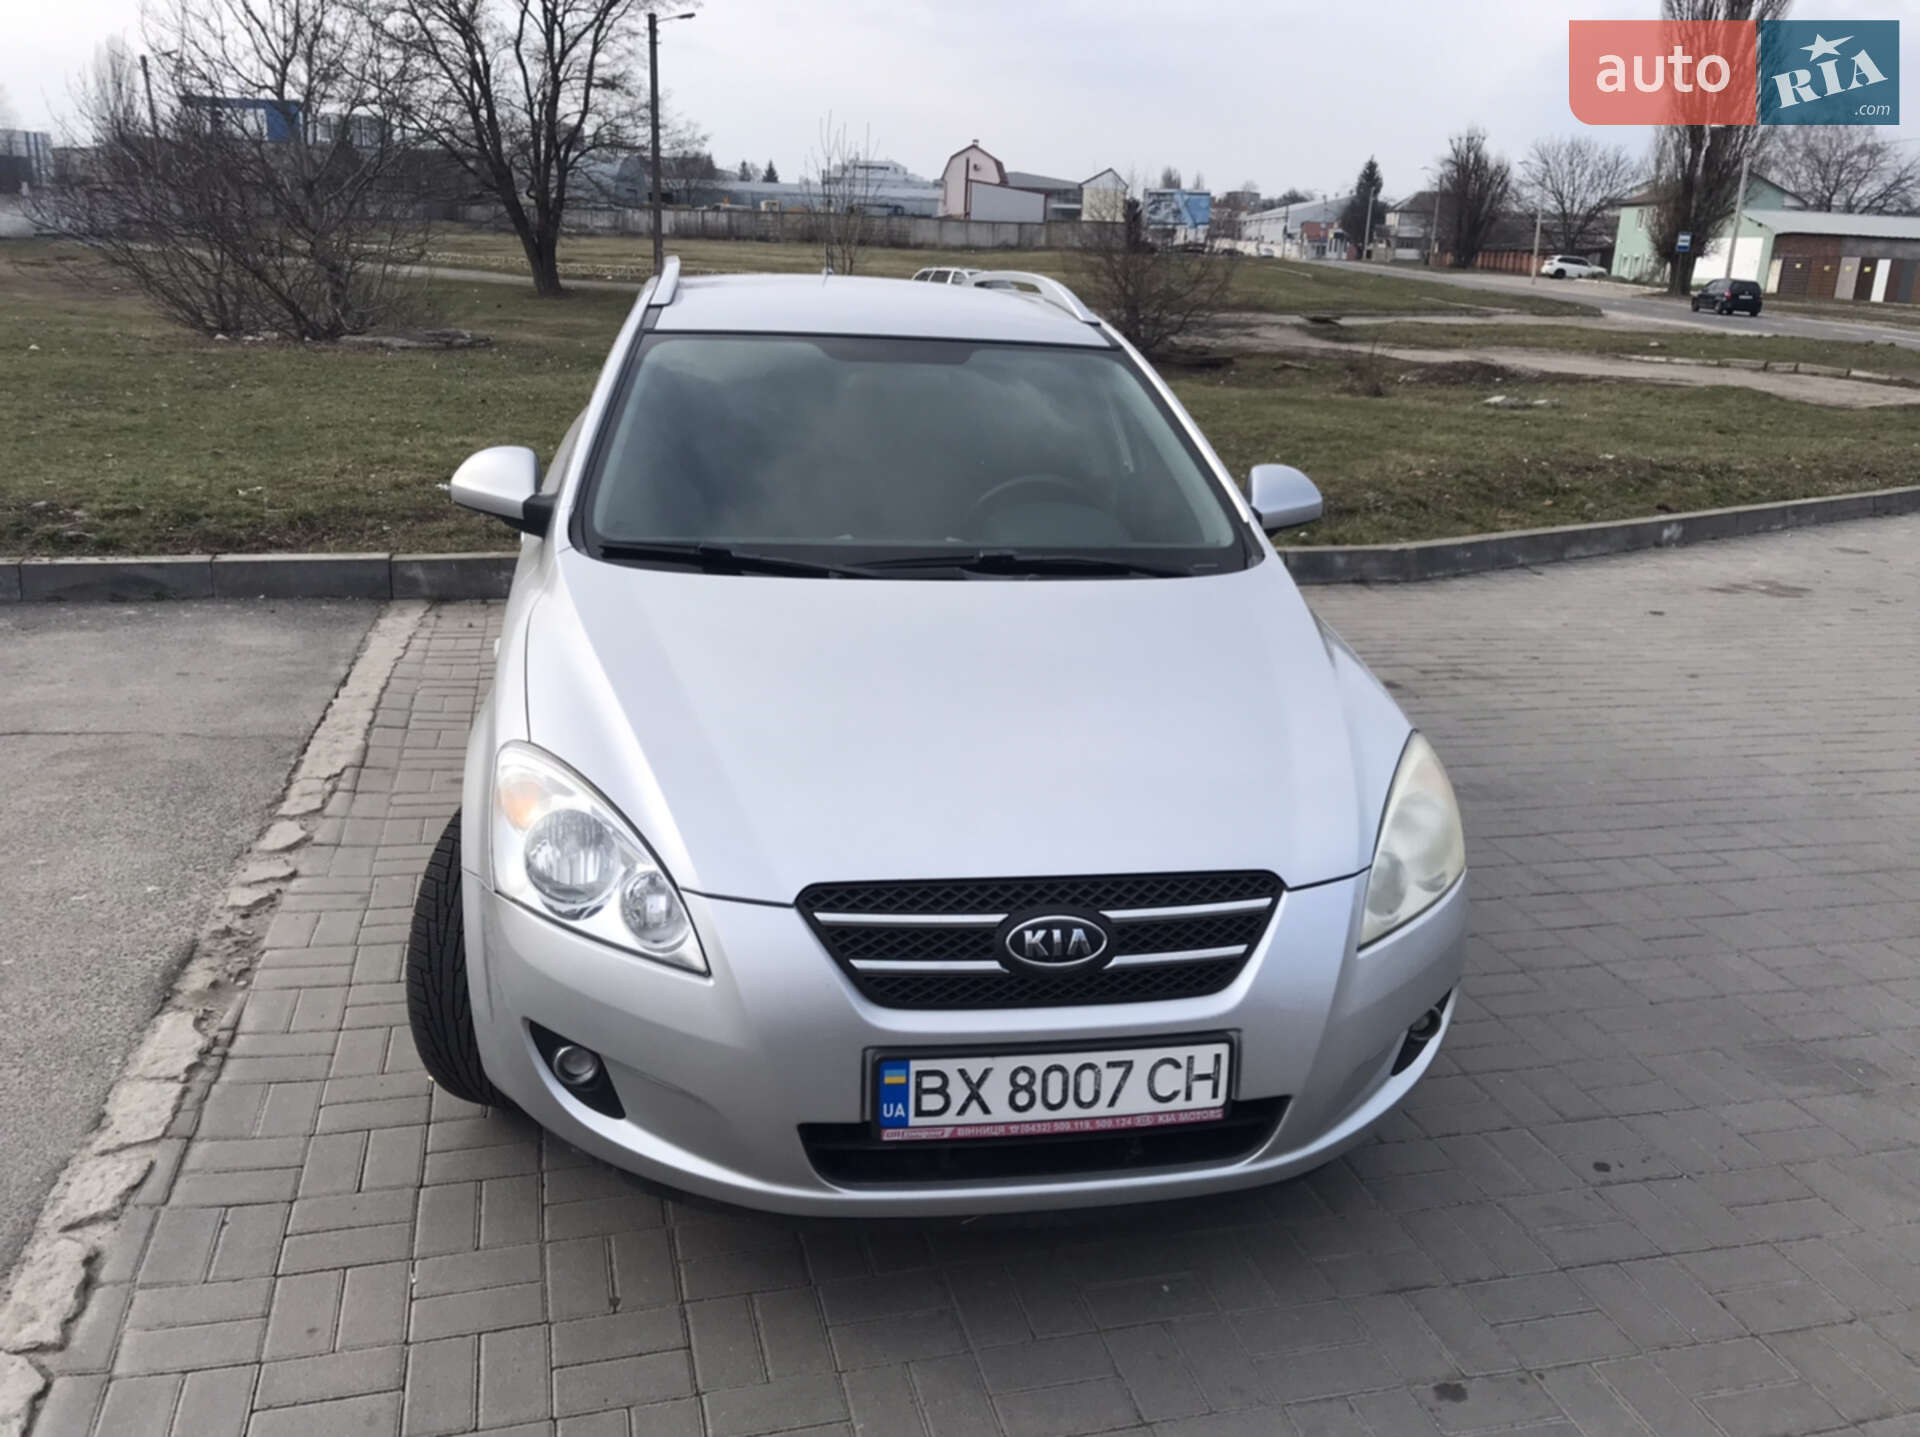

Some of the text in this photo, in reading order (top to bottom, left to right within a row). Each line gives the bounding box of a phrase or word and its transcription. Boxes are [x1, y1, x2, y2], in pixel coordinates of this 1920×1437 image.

[1024, 928, 1092, 956] KIA
[914, 1053, 1222, 1118] BX 8007 CH
[883, 1103, 905, 1119] UA
